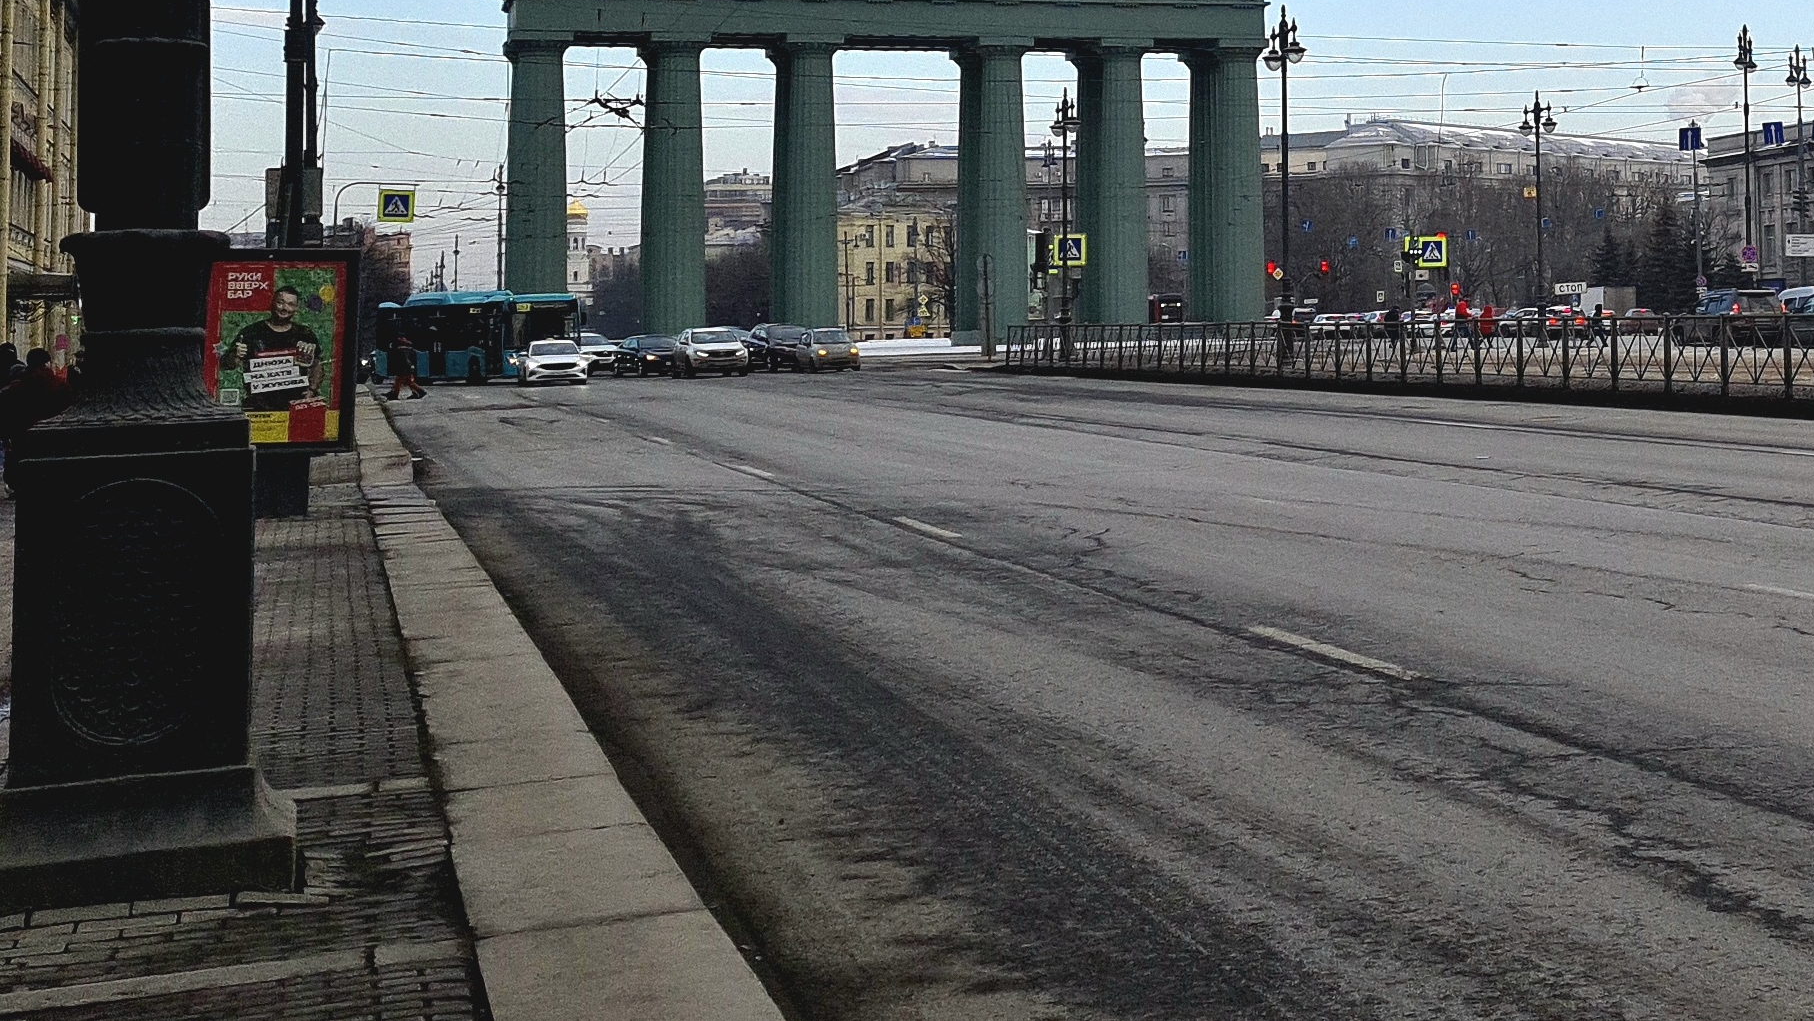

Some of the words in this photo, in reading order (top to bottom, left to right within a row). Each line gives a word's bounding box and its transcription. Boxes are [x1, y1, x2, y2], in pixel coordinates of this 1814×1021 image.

[228, 272, 259, 281] РУКИ
[228, 281, 269, 290] ВВЕРХ
[1559, 283, 1583, 292] СТОП
[227, 290, 253, 299] БАР
